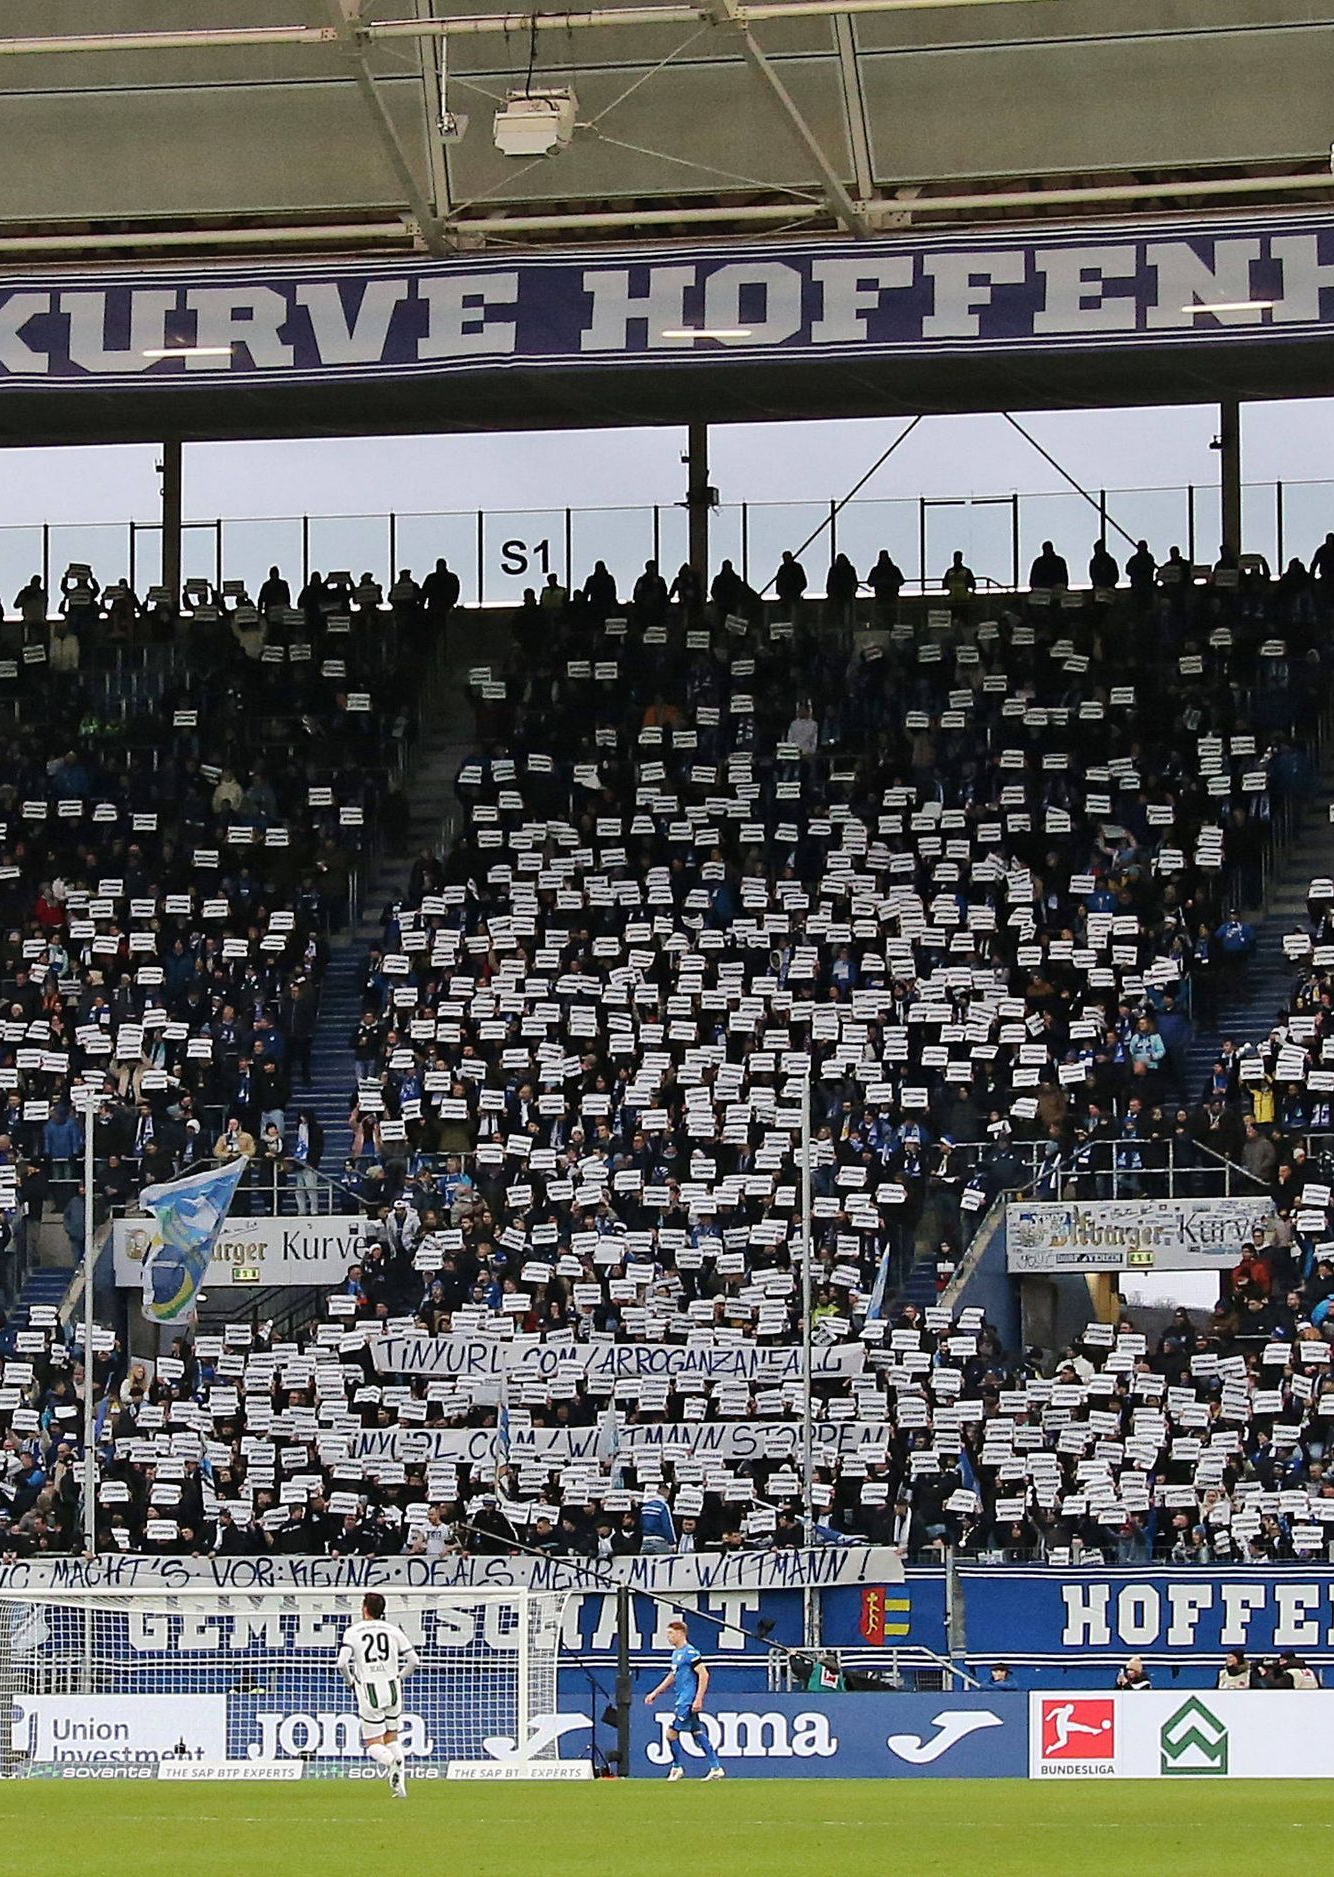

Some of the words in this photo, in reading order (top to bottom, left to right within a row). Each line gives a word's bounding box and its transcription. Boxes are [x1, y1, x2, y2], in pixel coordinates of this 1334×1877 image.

[500, 538, 550, 575] S1
[1178, 1211, 1257, 1245] Kurv
[282, 1230, 367, 1262] Kurve
[361, 1632, 390, 1664] 29
[53, 1718, 129, 1741] Union
[63, 1766, 152, 1779] sovanta
[166, 1767, 189, 1778] THE
[192, 1767, 214, 1778] SAP
[217, 1767, 240, 1778] BTP
[243, 1767, 296, 1778] EXPERTS
[454, 1768, 476, 1778] THE
[479, 1768, 502, 1778] SAP
[531, 1768, 583, 1778] EXPERTS
[1041, 1765, 1115, 1775] BUNDESLIGA
